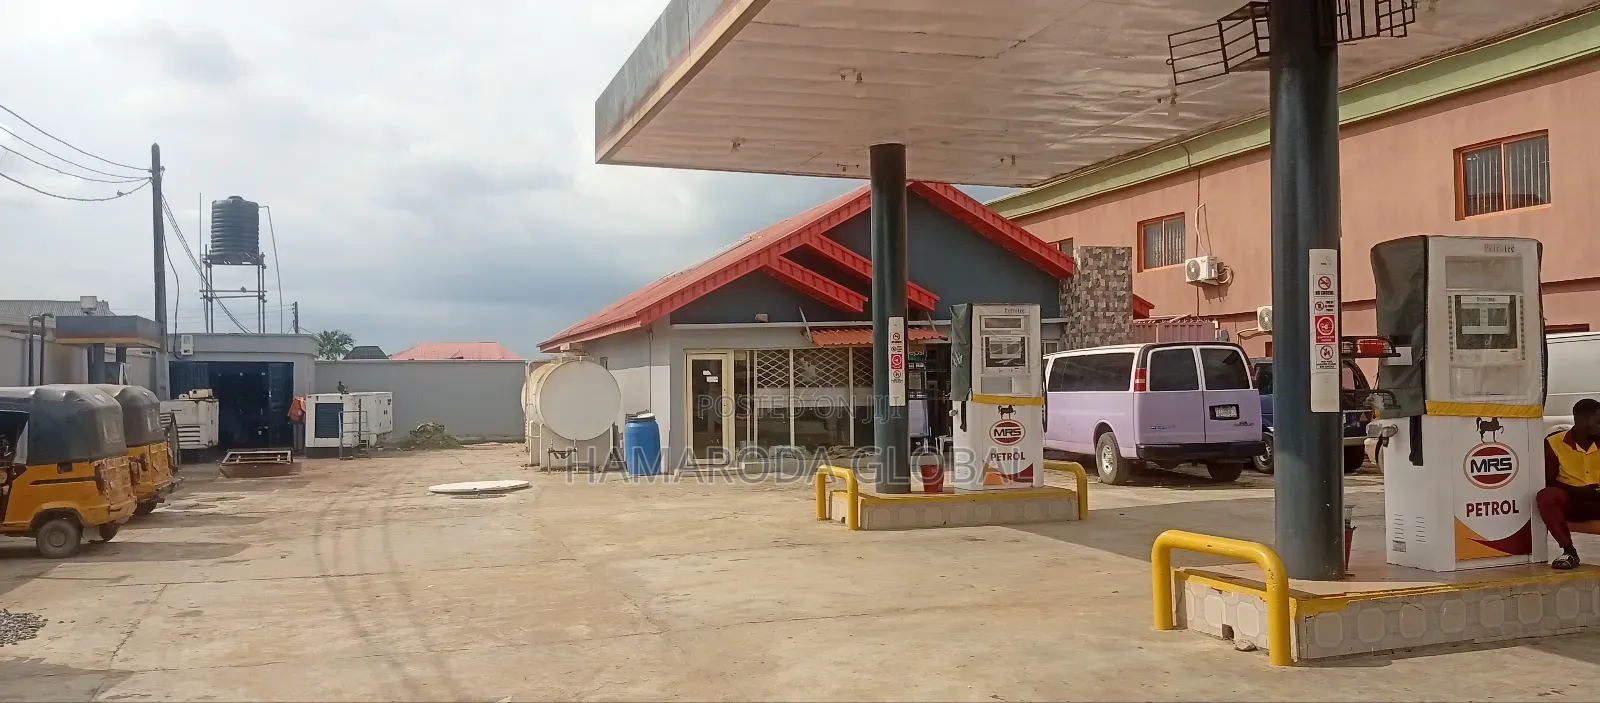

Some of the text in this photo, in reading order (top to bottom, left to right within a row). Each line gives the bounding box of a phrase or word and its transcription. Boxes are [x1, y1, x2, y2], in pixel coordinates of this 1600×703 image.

[993, 427, 1022, 437] MRS
[990, 451, 1026, 461] PETROL
[1470, 457, 1513, 474] MRS
[1466, 499, 1520, 518] PETROL
